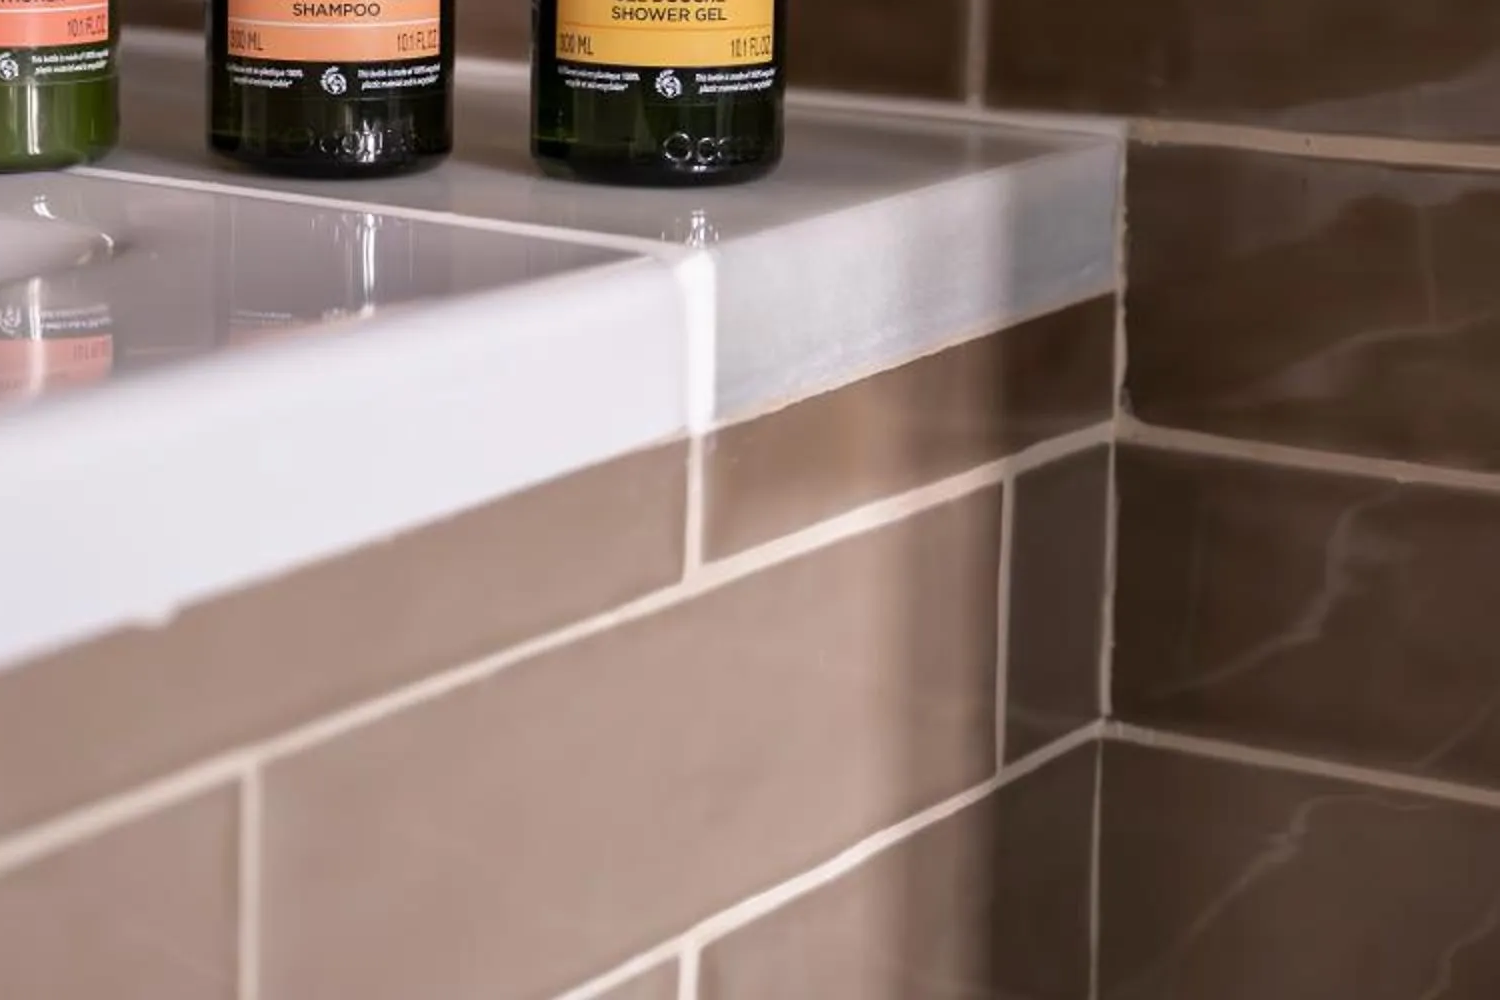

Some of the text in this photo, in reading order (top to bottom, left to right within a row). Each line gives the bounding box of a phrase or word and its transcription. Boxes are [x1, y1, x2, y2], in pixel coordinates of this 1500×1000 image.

[292, 3, 381, 17] SHAMPOO
[611, 7, 728, 22] SHOWER GEL
